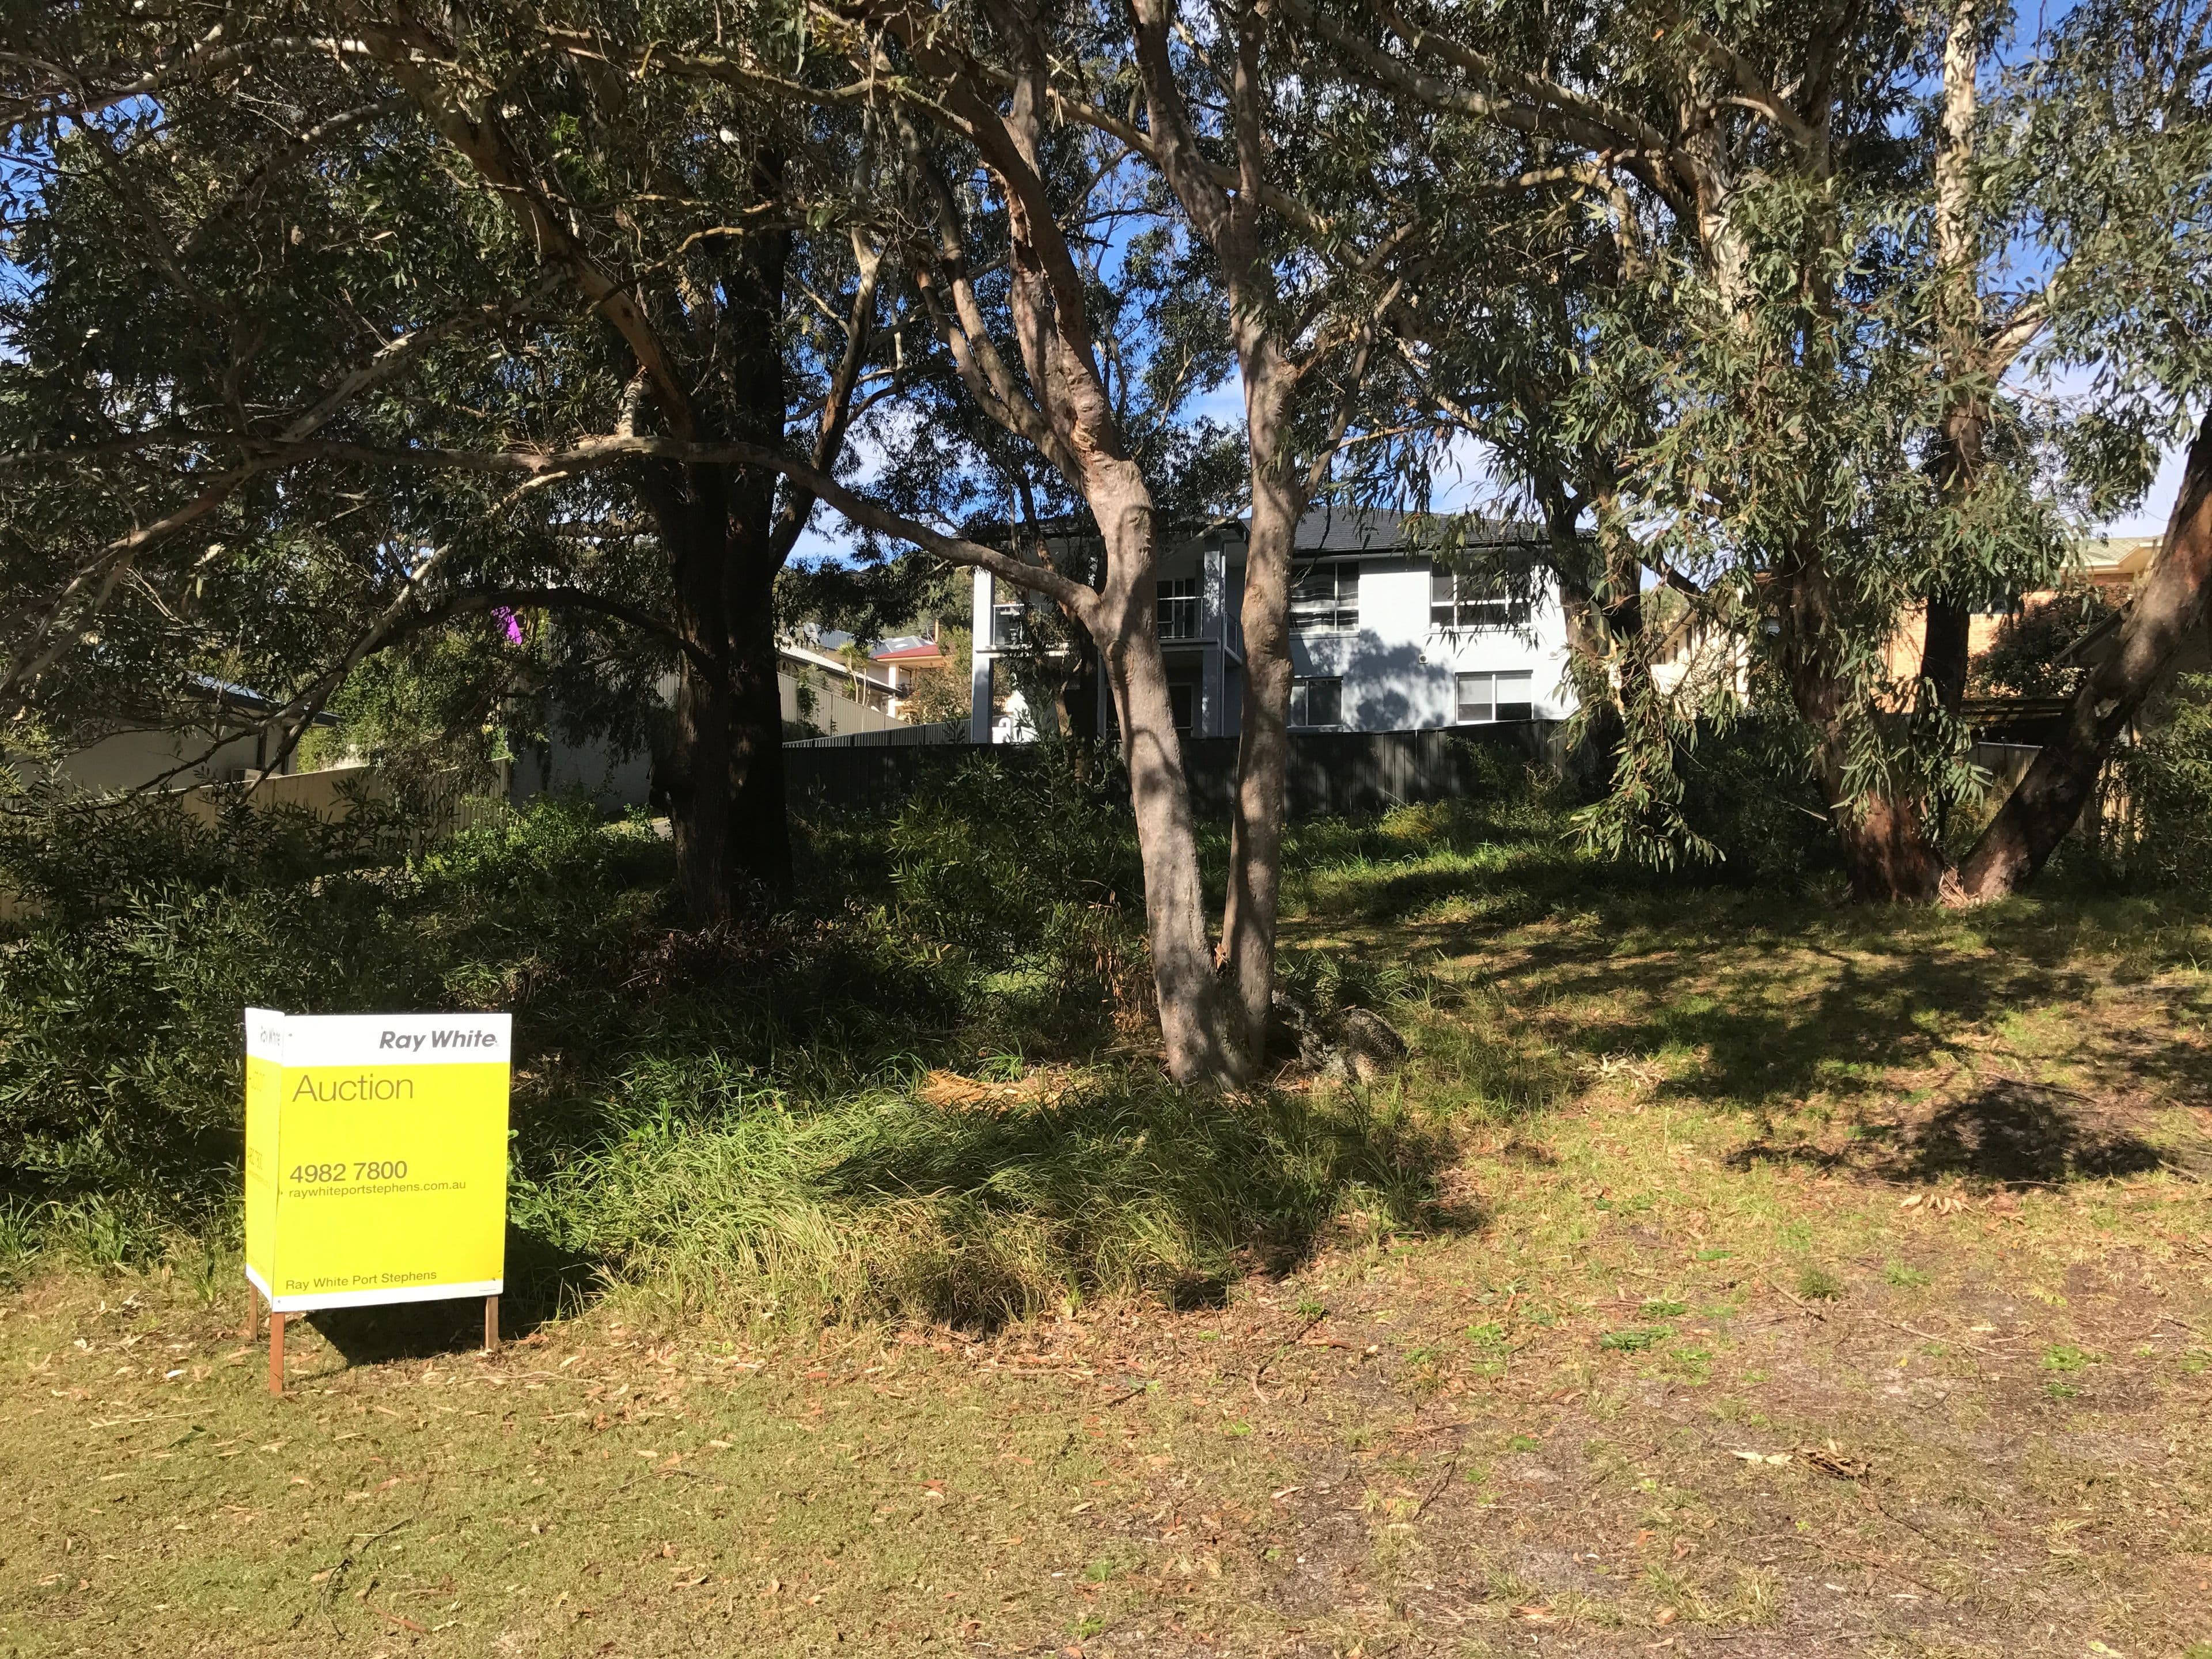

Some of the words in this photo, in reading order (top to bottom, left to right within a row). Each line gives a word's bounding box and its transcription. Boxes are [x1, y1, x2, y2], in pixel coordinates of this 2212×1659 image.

[379, 1031, 426, 1052] Ray
[431, 1030, 498, 1048] White
[291, 1073, 413, 1102] Auction
[289, 1164, 346, 1183] 4982
[353, 1160, 408, 1180] 7800
[289, 1181, 466, 1199] raywhiteportstephens.com.au
[286, 1280, 309, 1291] Ray
[313, 1277, 349, 1287] White
[353, 1274, 377, 1285] Port
[381, 1271, 437, 1283] Stephens
